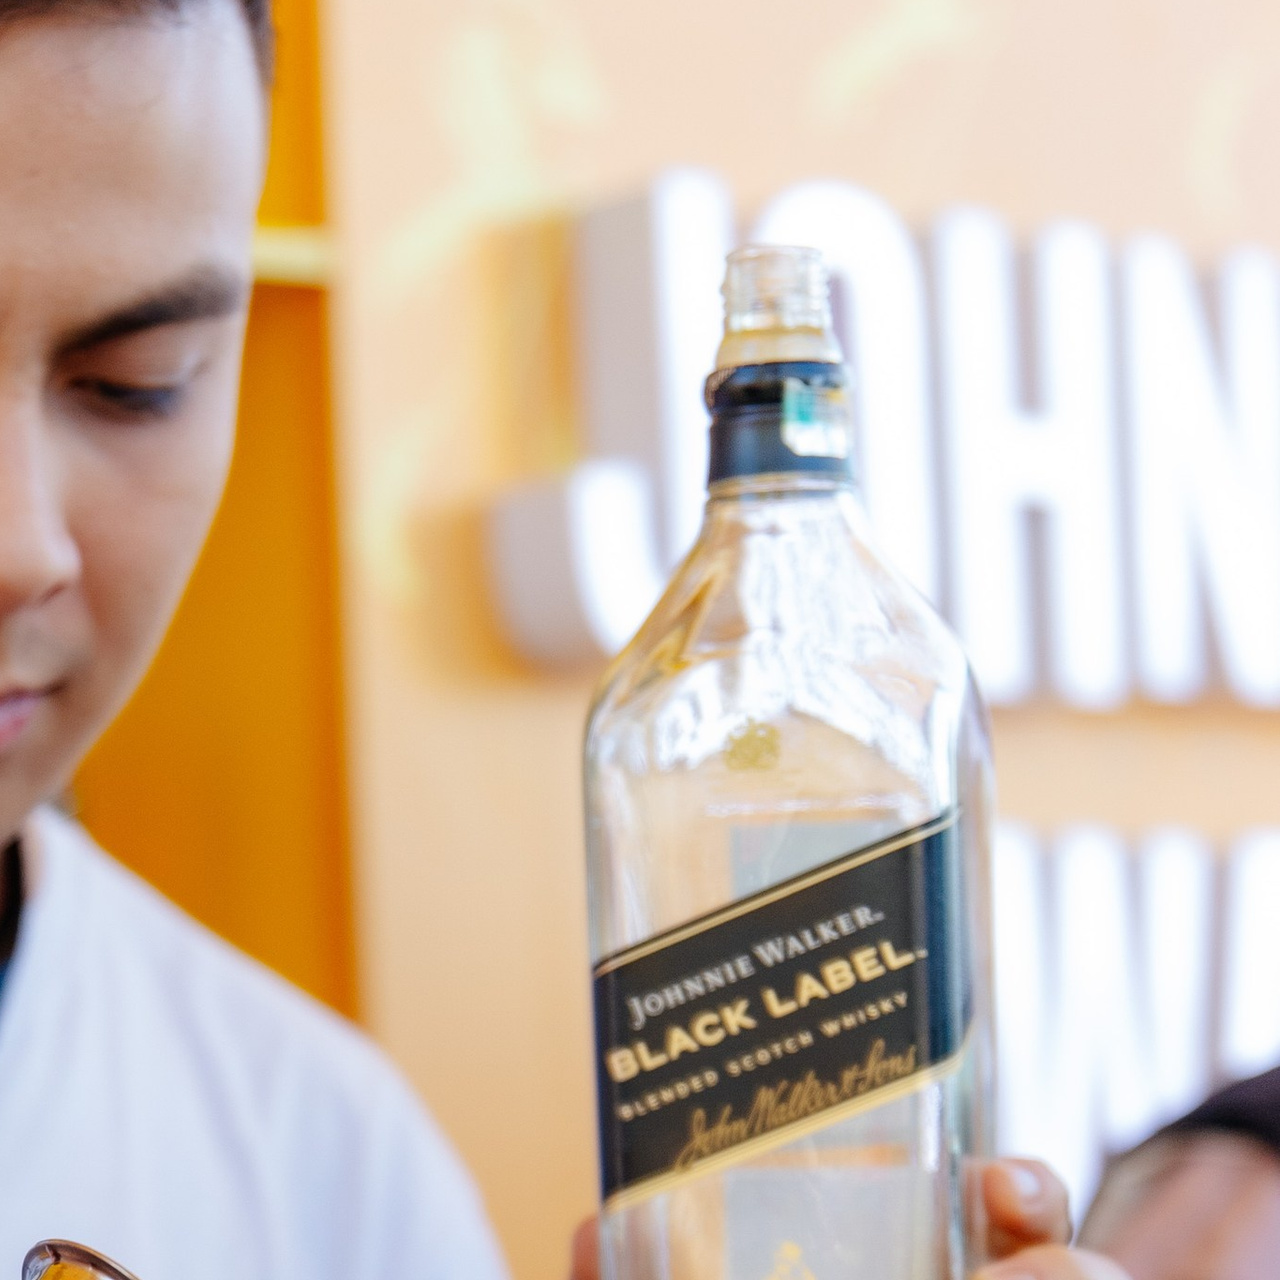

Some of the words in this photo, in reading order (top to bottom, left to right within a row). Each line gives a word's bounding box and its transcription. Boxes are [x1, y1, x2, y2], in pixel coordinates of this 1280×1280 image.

[627, 954, 756, 1031] JOHNNIE
[607, 997, 757, 1083] BLACK
[617, 1069, 720, 1122] BLENDED
[725, 1030, 815, 1078] SCOTCH
[820, 990, 908, 1038] WHISKY
